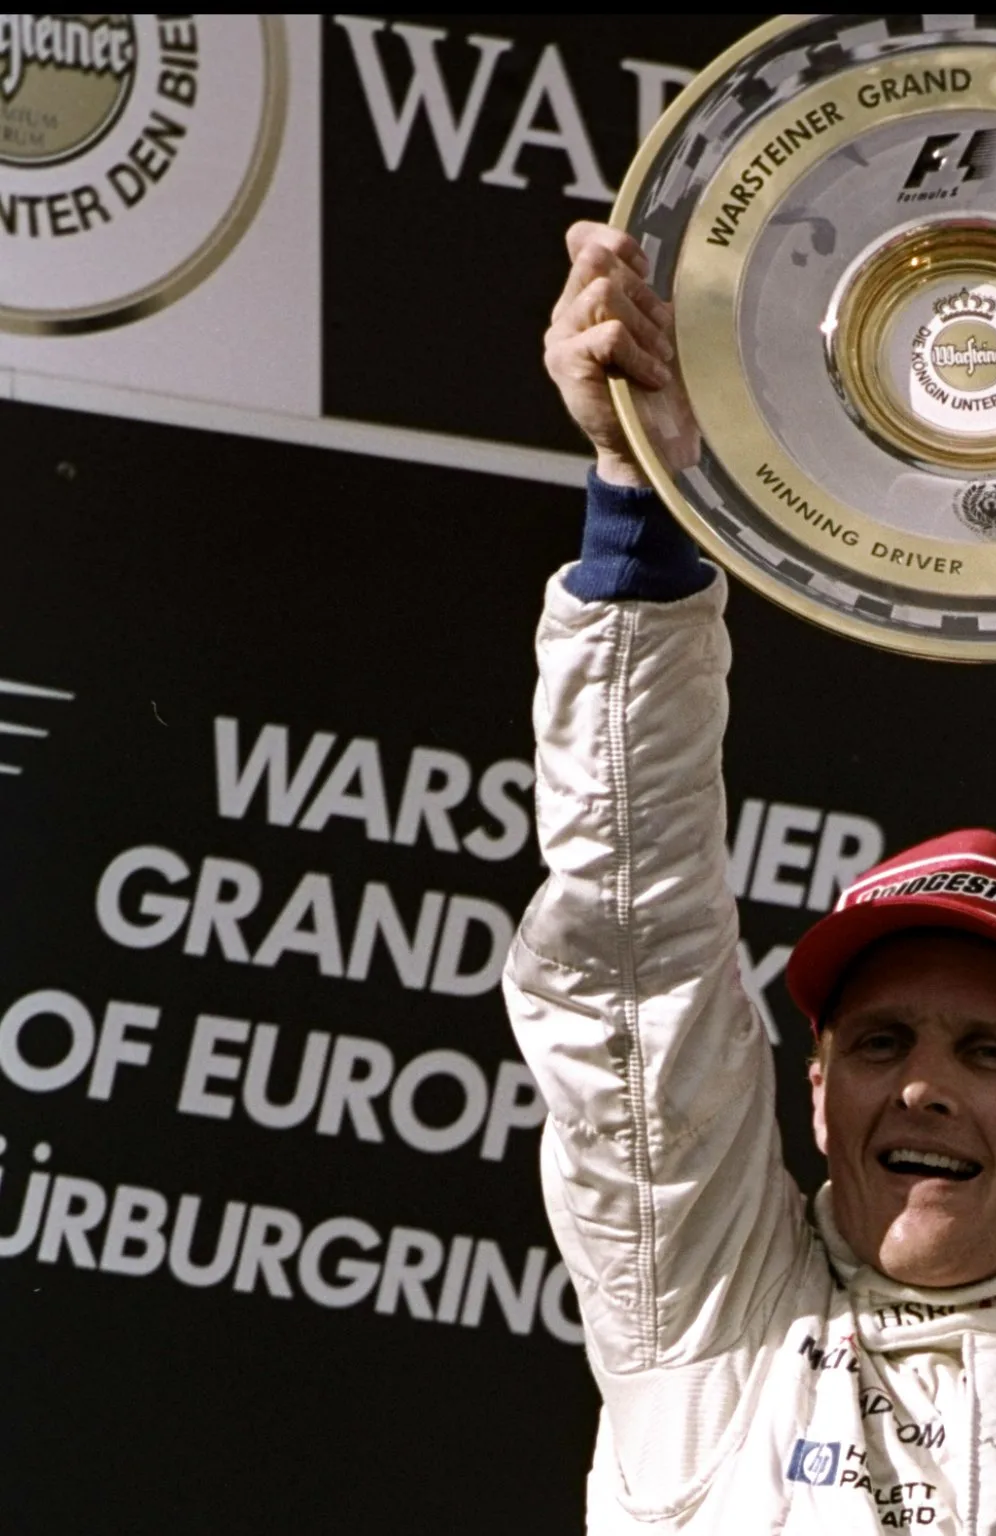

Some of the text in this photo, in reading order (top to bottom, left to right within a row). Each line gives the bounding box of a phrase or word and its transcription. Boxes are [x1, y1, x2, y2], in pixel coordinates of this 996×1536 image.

[0, 14, 136, 98] steiner
[0, 14, 199, 237] NTER DEN BIE
[707, 101, 844, 248] WARSTEINER
[857, 68, 972, 108] GRAND
[897, 188, 948, 203] Formula
[912, 325, 932, 349] DIE
[912, 351, 949, 404] KÖNIGIN
[755, 463, 968, 576] WINNING DRIVER
[95, 845, 514, 998] GRAND
[0, 988, 551, 1162] OF EUROP
